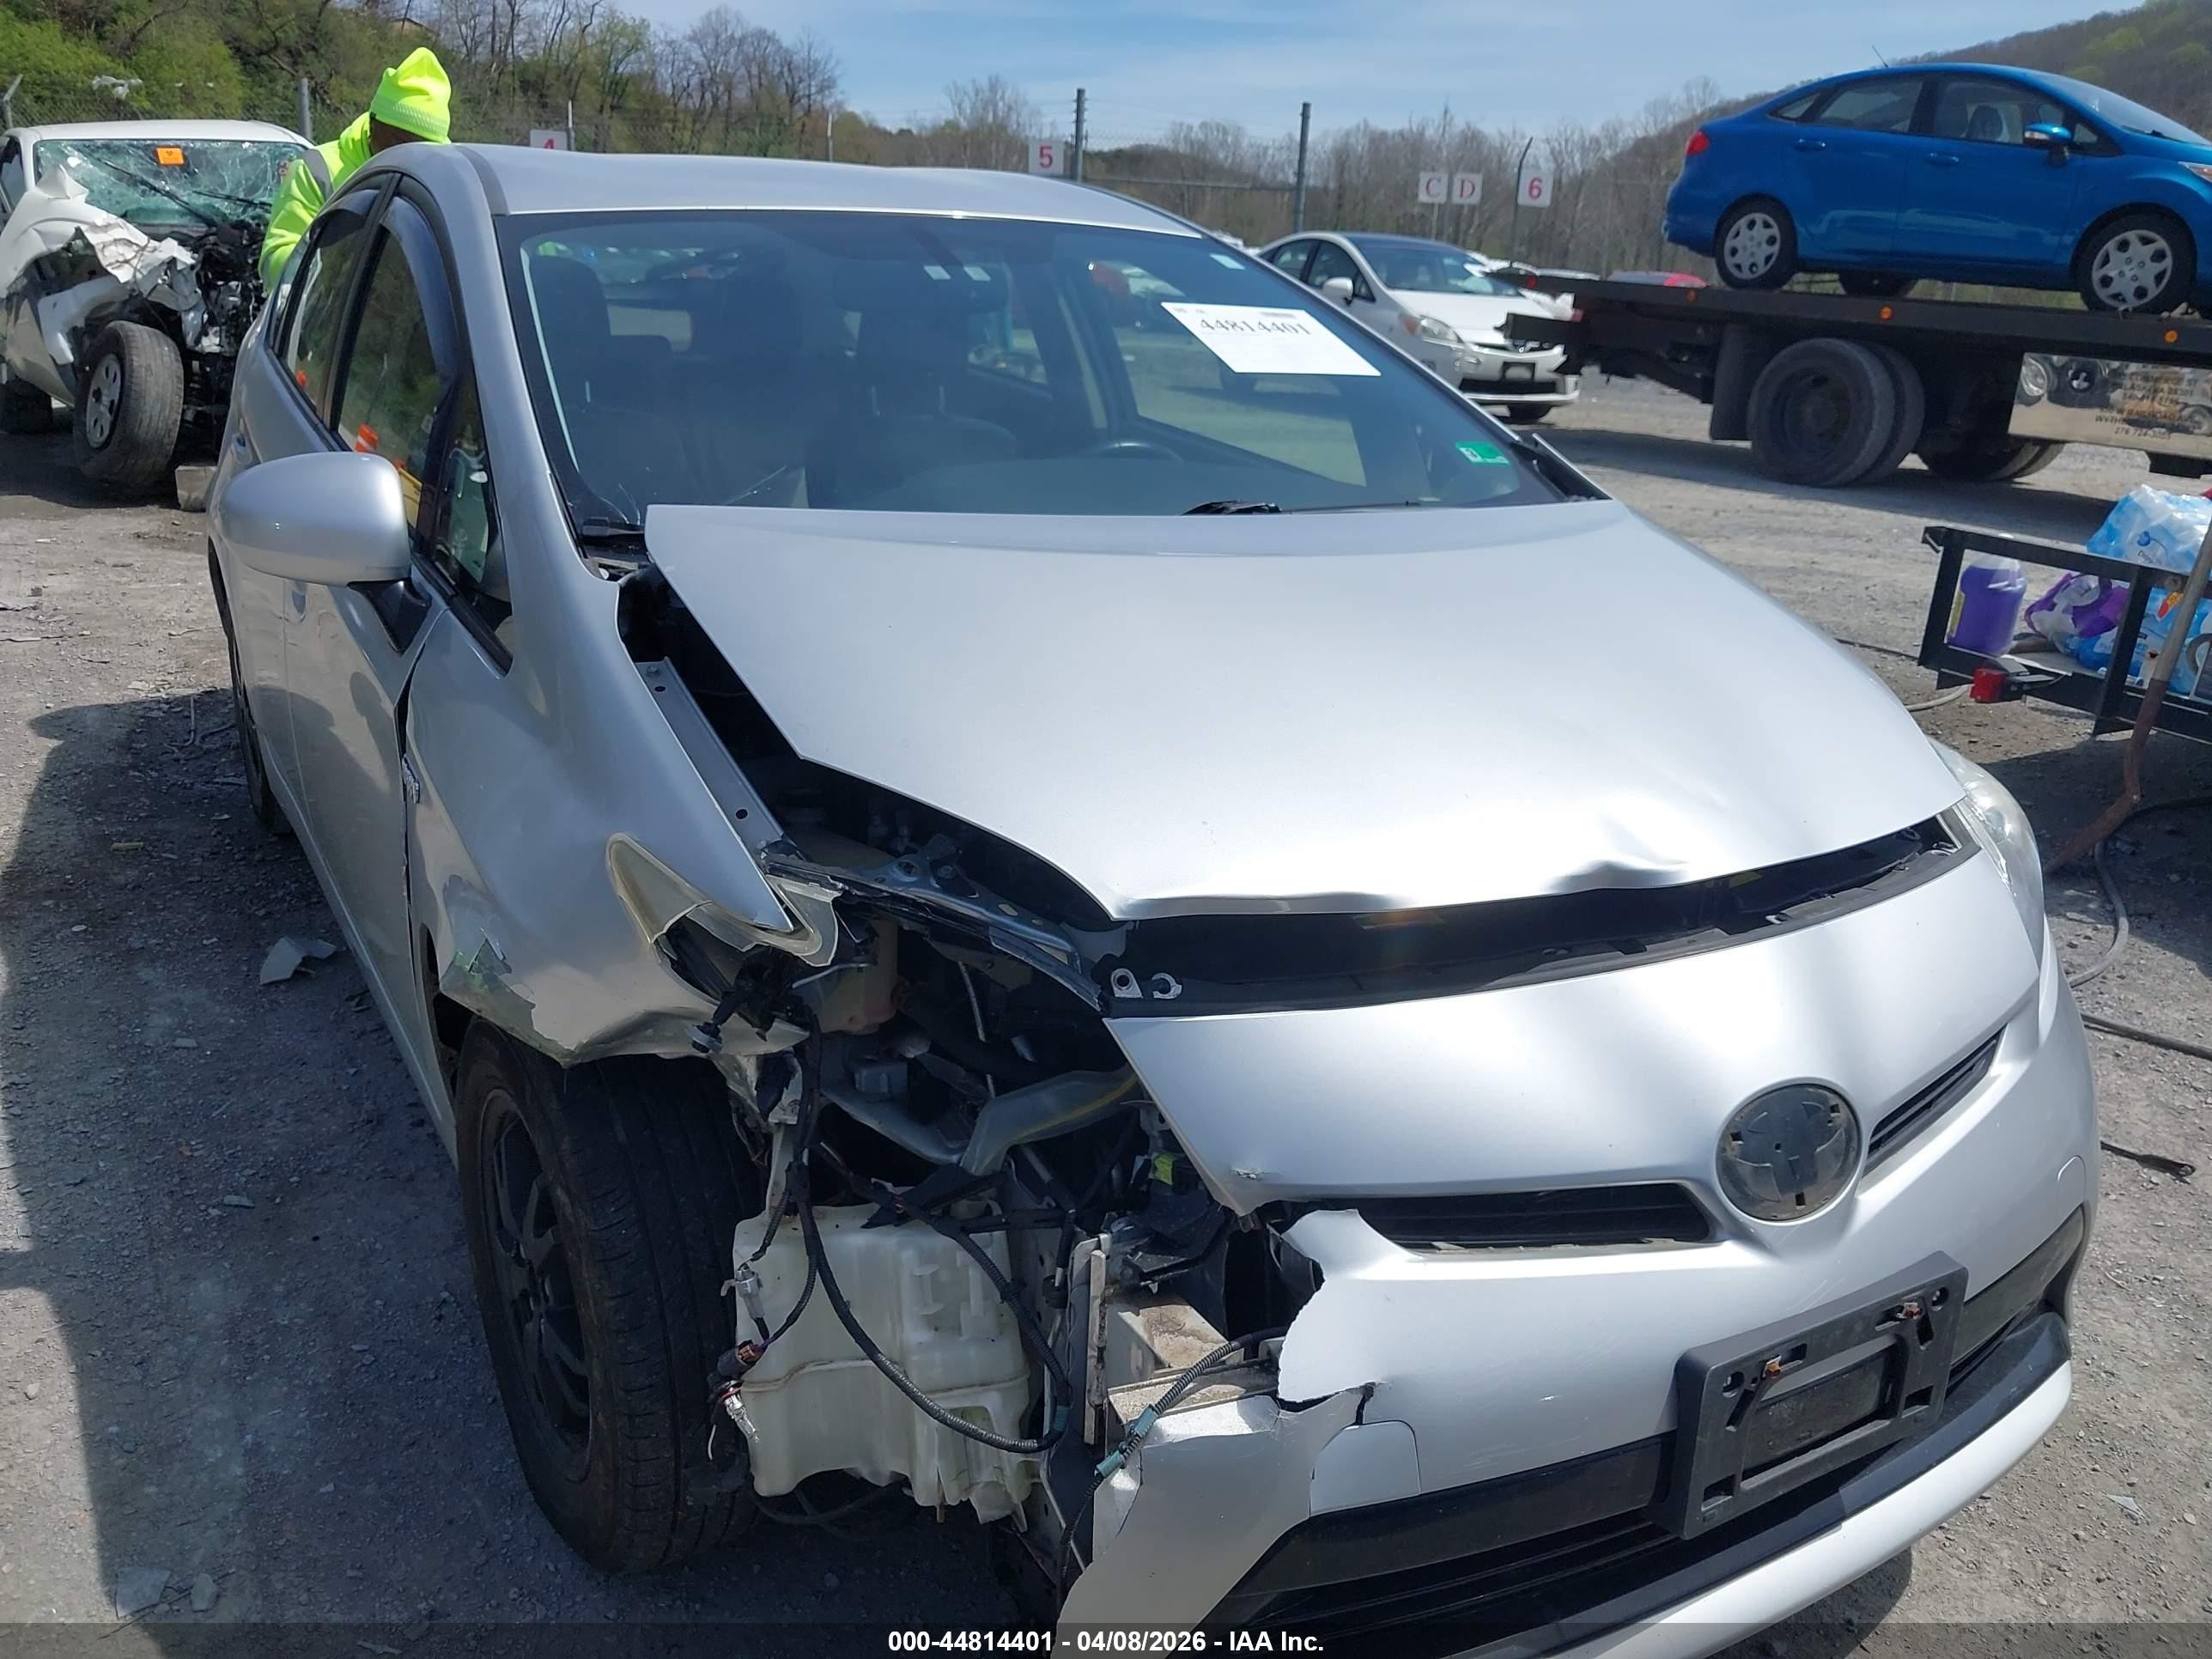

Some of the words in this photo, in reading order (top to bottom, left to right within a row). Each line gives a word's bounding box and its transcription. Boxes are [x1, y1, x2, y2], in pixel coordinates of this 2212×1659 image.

[1039, 145, 1053, 169] 5
[1425, 177, 1441, 198] C
[1460, 179, 1475, 199] D
[1528, 177, 1543, 200] 6
[1200, 318, 1312, 336] 44814401
